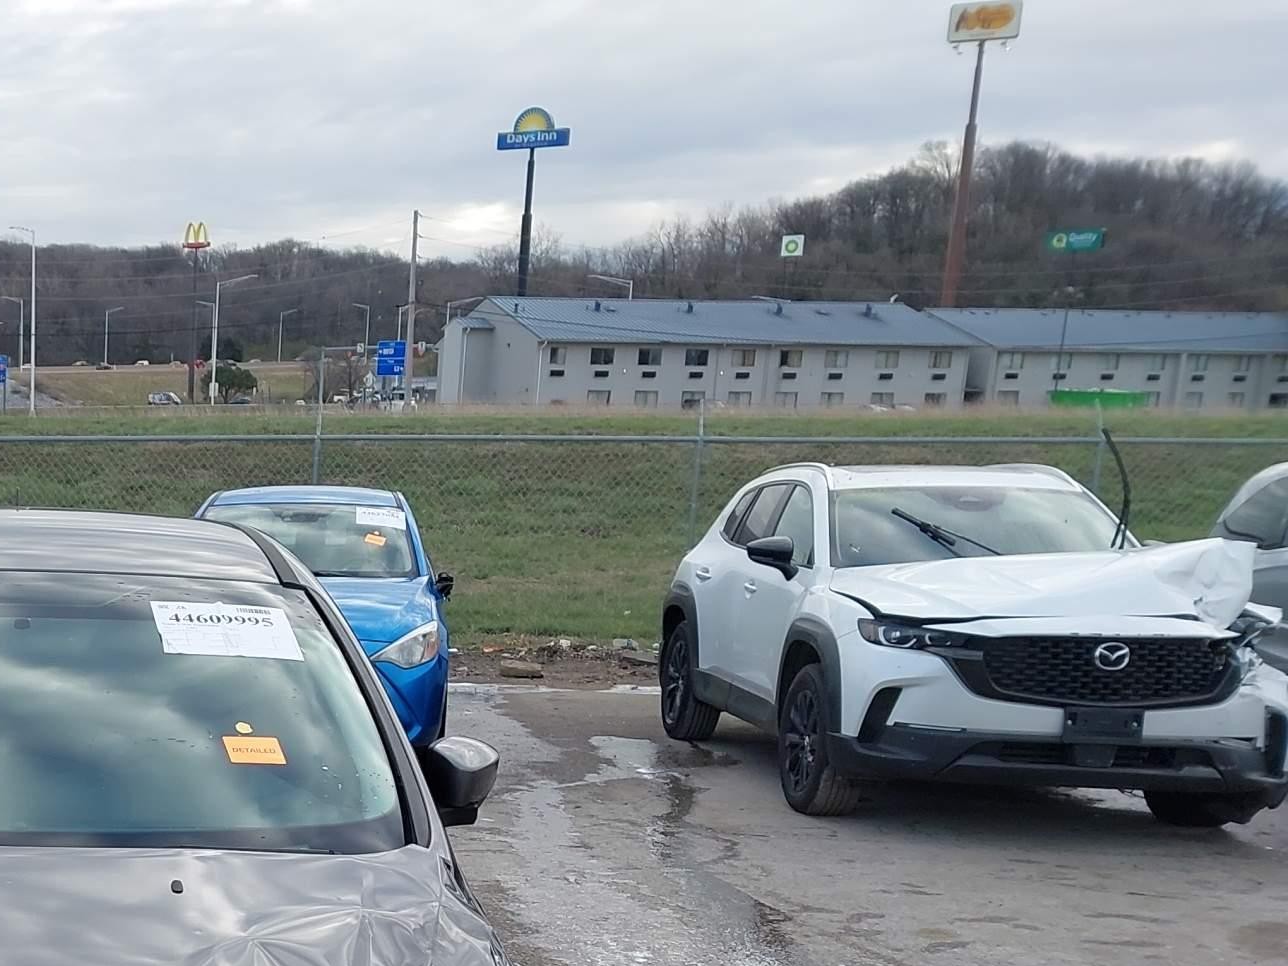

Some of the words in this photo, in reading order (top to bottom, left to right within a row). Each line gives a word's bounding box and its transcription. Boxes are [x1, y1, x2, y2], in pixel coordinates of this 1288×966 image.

[506, 132, 536, 144] Days
[537, 131, 557, 141] Inn
[168, 611, 275, 627] 44609995
